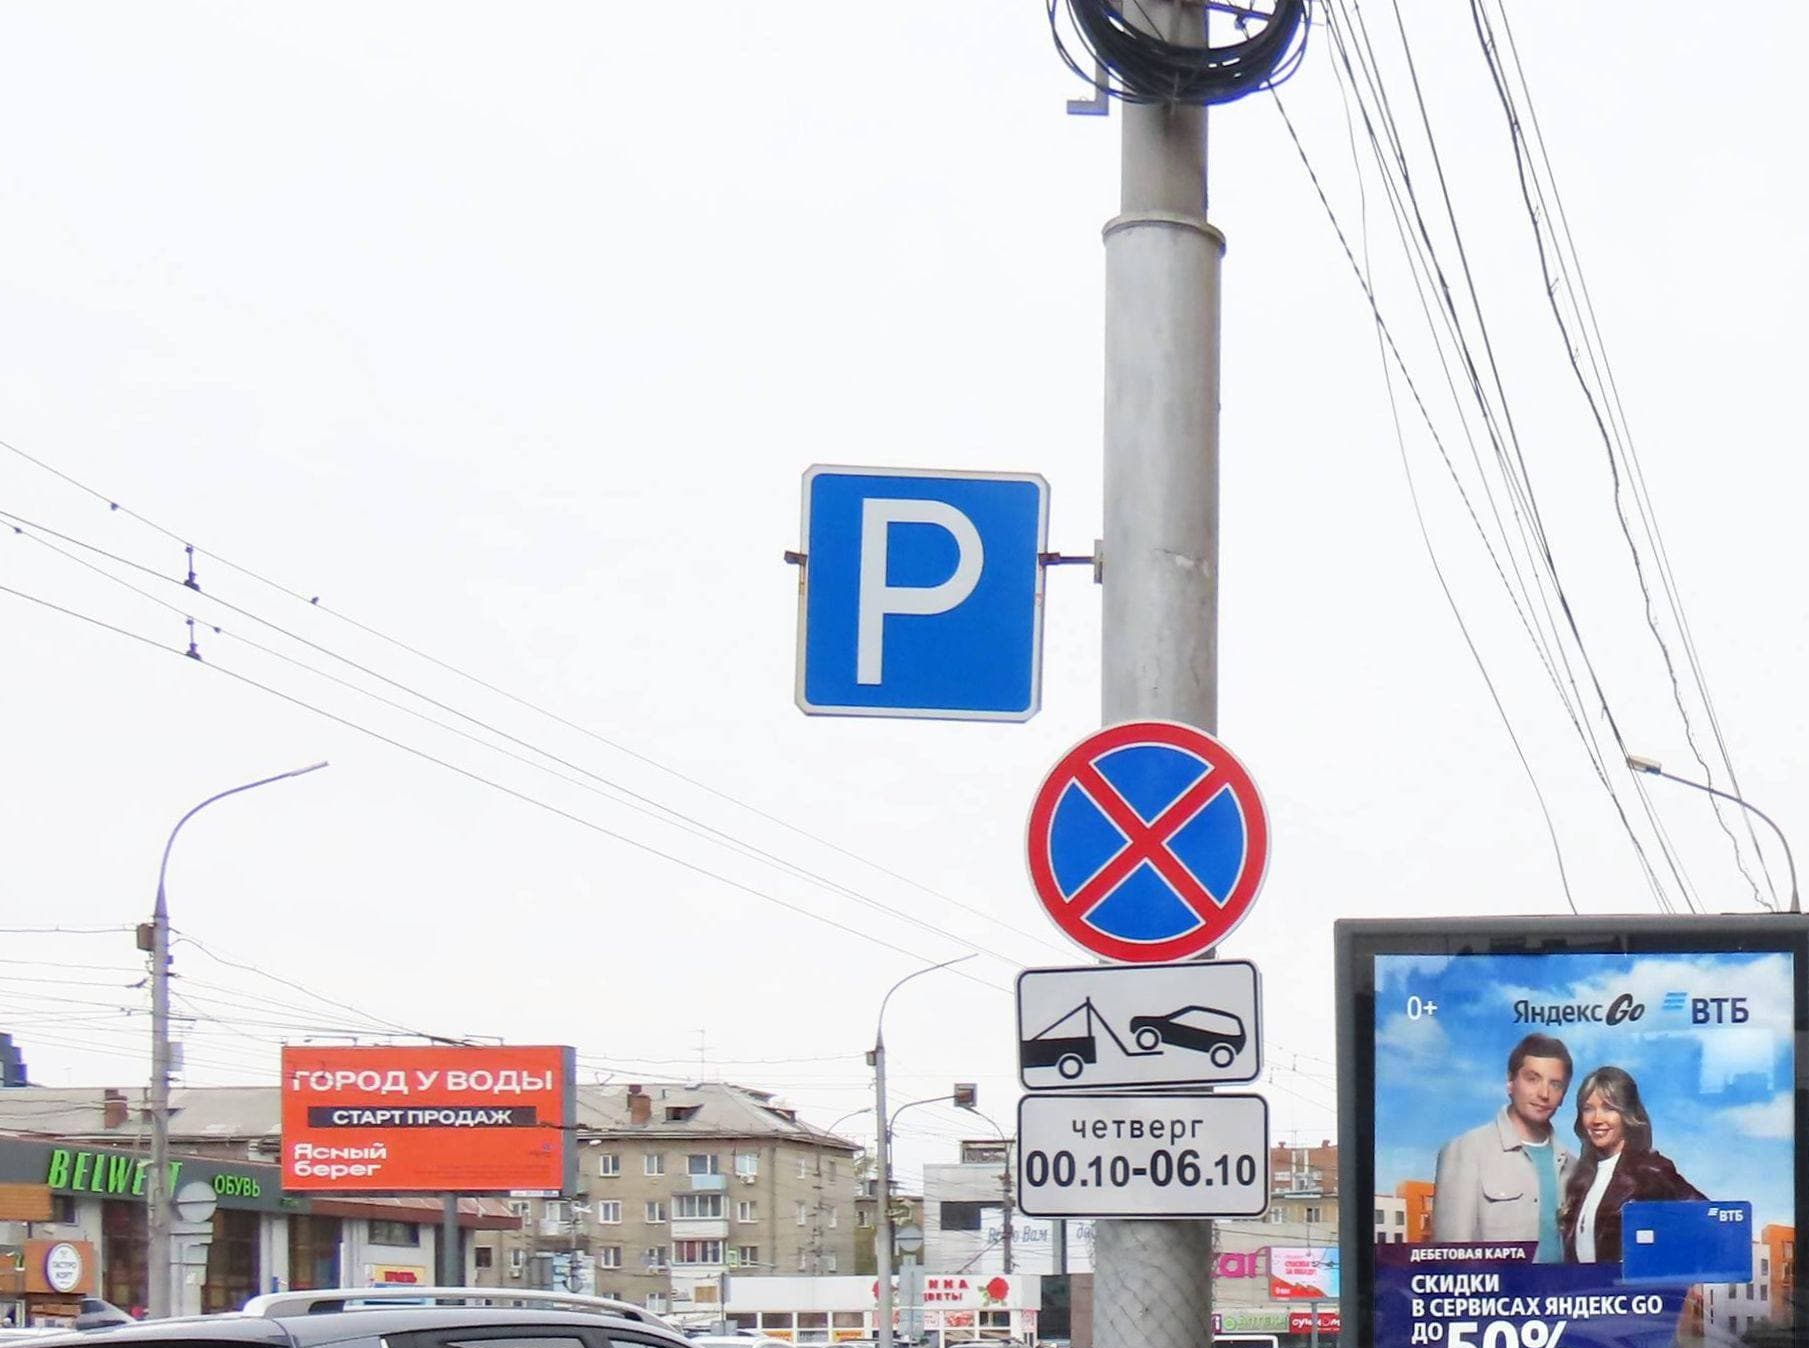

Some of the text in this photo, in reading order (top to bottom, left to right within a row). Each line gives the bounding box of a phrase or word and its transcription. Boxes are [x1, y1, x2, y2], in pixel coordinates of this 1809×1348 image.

[857, 497, 984, 686] P
[1407, 995, 1438, 1021] 0+
[1512, 993, 1646, 1027] Яндекс Go
[1691, 997, 1750, 1025] ВТБ
[292, 1070, 553, 1095] ГОРОД У ВОДЫ
[332, 1109, 513, 1127] СТАРТ ПРОДАЖ
[1072, 1118, 1205, 1146] четверг
[294, 1142, 388, 1160] Ясный
[48, 1149, 184, 1198] BELWET
[294, 1160, 381, 1180] берег
[1026, 1149, 1257, 1188] 00.10-06.10
[214, 1174, 262, 1198] ОБУВЬ
[1719, 1209, 1744, 1222] ВТБ
[1410, 1247, 1526, 1263] ДЕБЕТОВАЯ КАРТА
[1411, 1274, 1500, 1297] СКИДКИ
[1412, 1296, 1663, 1319] В СЕРВИСАХ ЯНДЕКС GO
[1411, 1322, 1443, 1345] ДО
